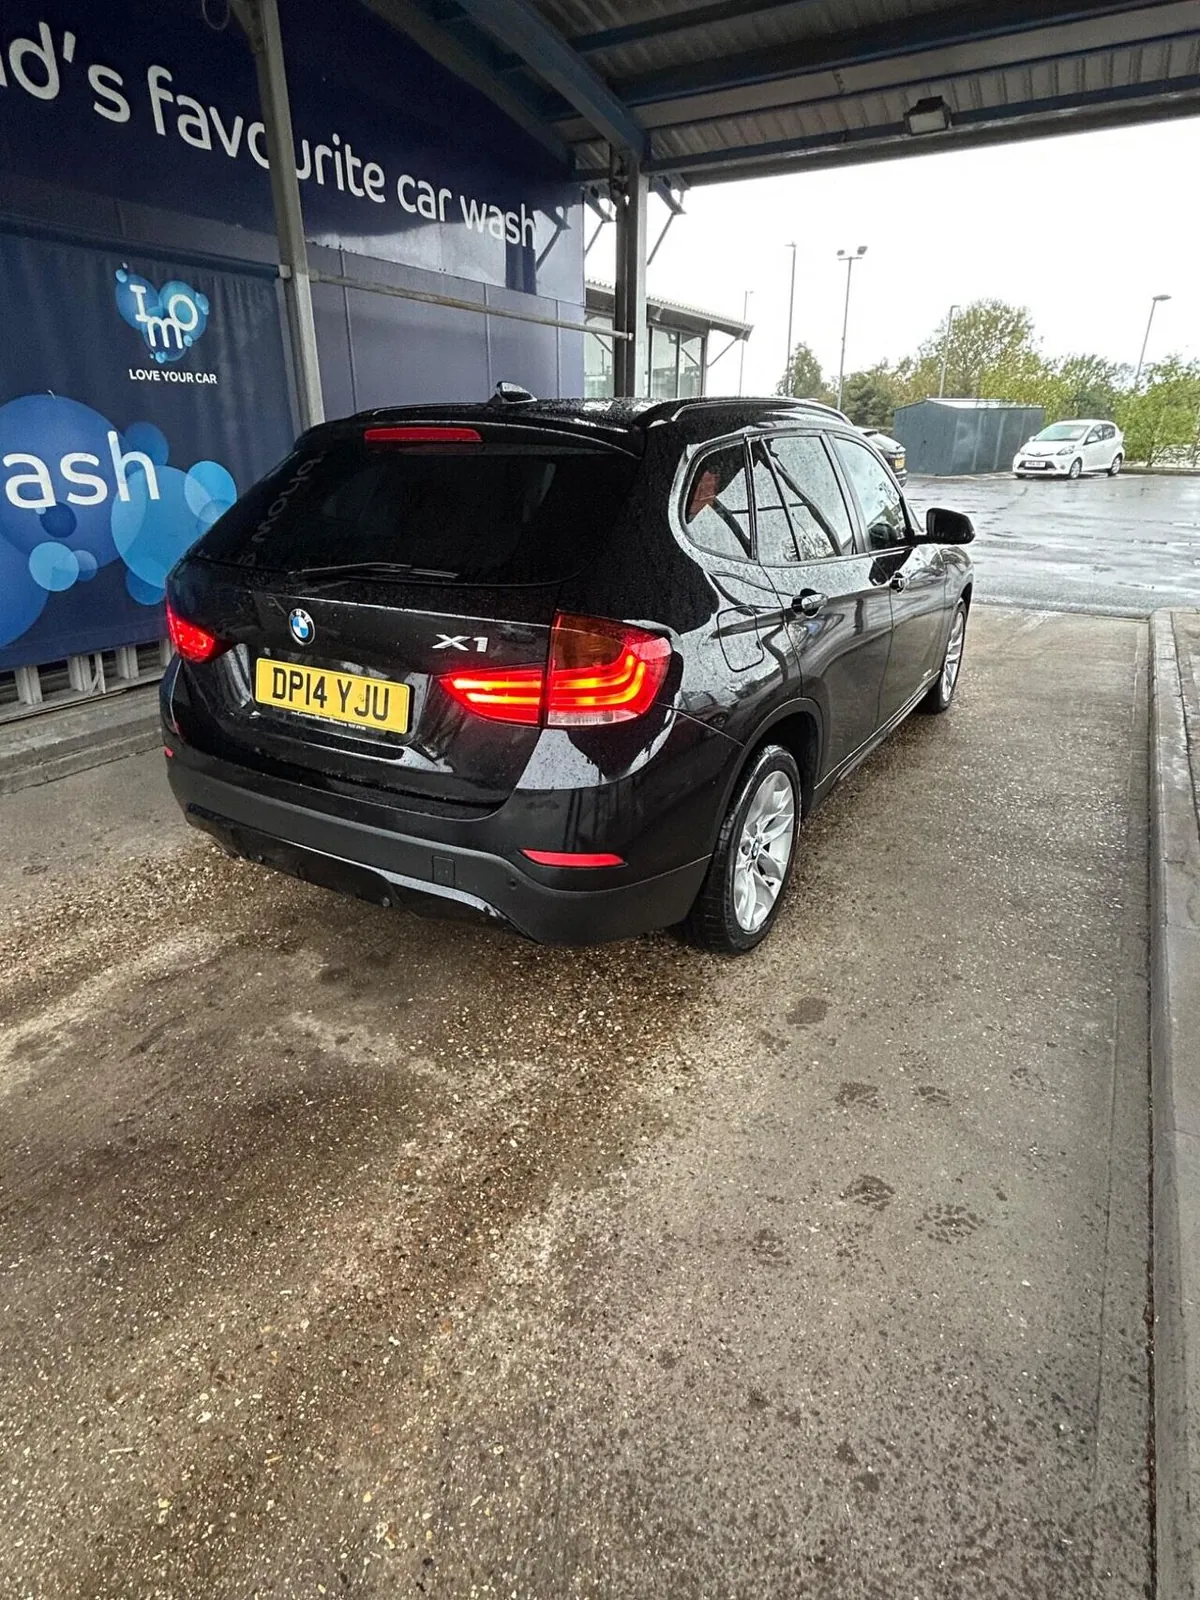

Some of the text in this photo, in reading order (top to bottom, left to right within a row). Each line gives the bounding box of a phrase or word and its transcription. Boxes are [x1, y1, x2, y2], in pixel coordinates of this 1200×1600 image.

[396, 173, 452, 223] car
[459, 202, 537, 250] wash
[128, 368, 218, 384] LOVE YOUR CAR
[3, 430, 160, 509] ash
[432, 633, 489, 653] X1
[271, 666, 328, 709] DP14
[336, 678, 390, 722] YJU
